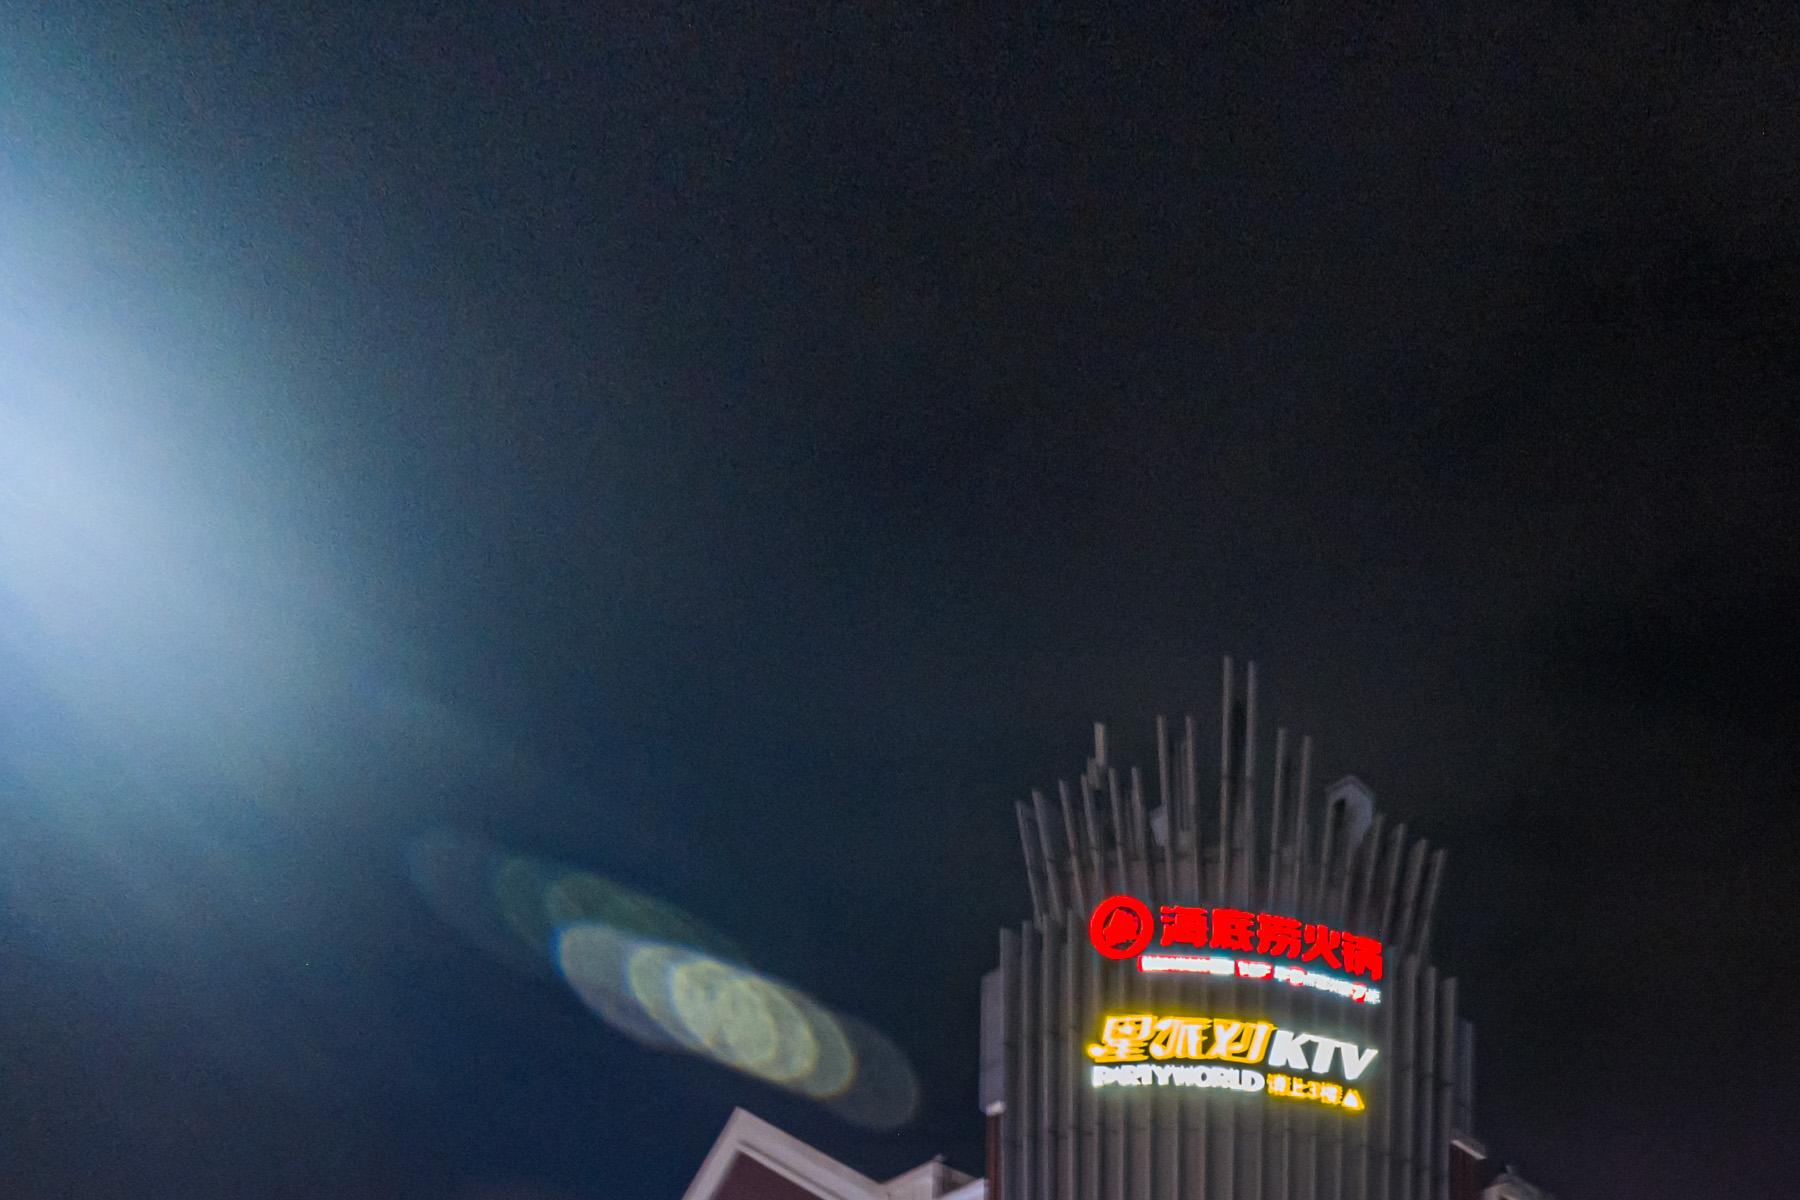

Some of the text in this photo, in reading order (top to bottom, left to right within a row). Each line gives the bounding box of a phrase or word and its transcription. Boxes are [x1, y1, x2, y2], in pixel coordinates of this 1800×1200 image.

[1160, 905, 1383, 980] 海底捞火锅
